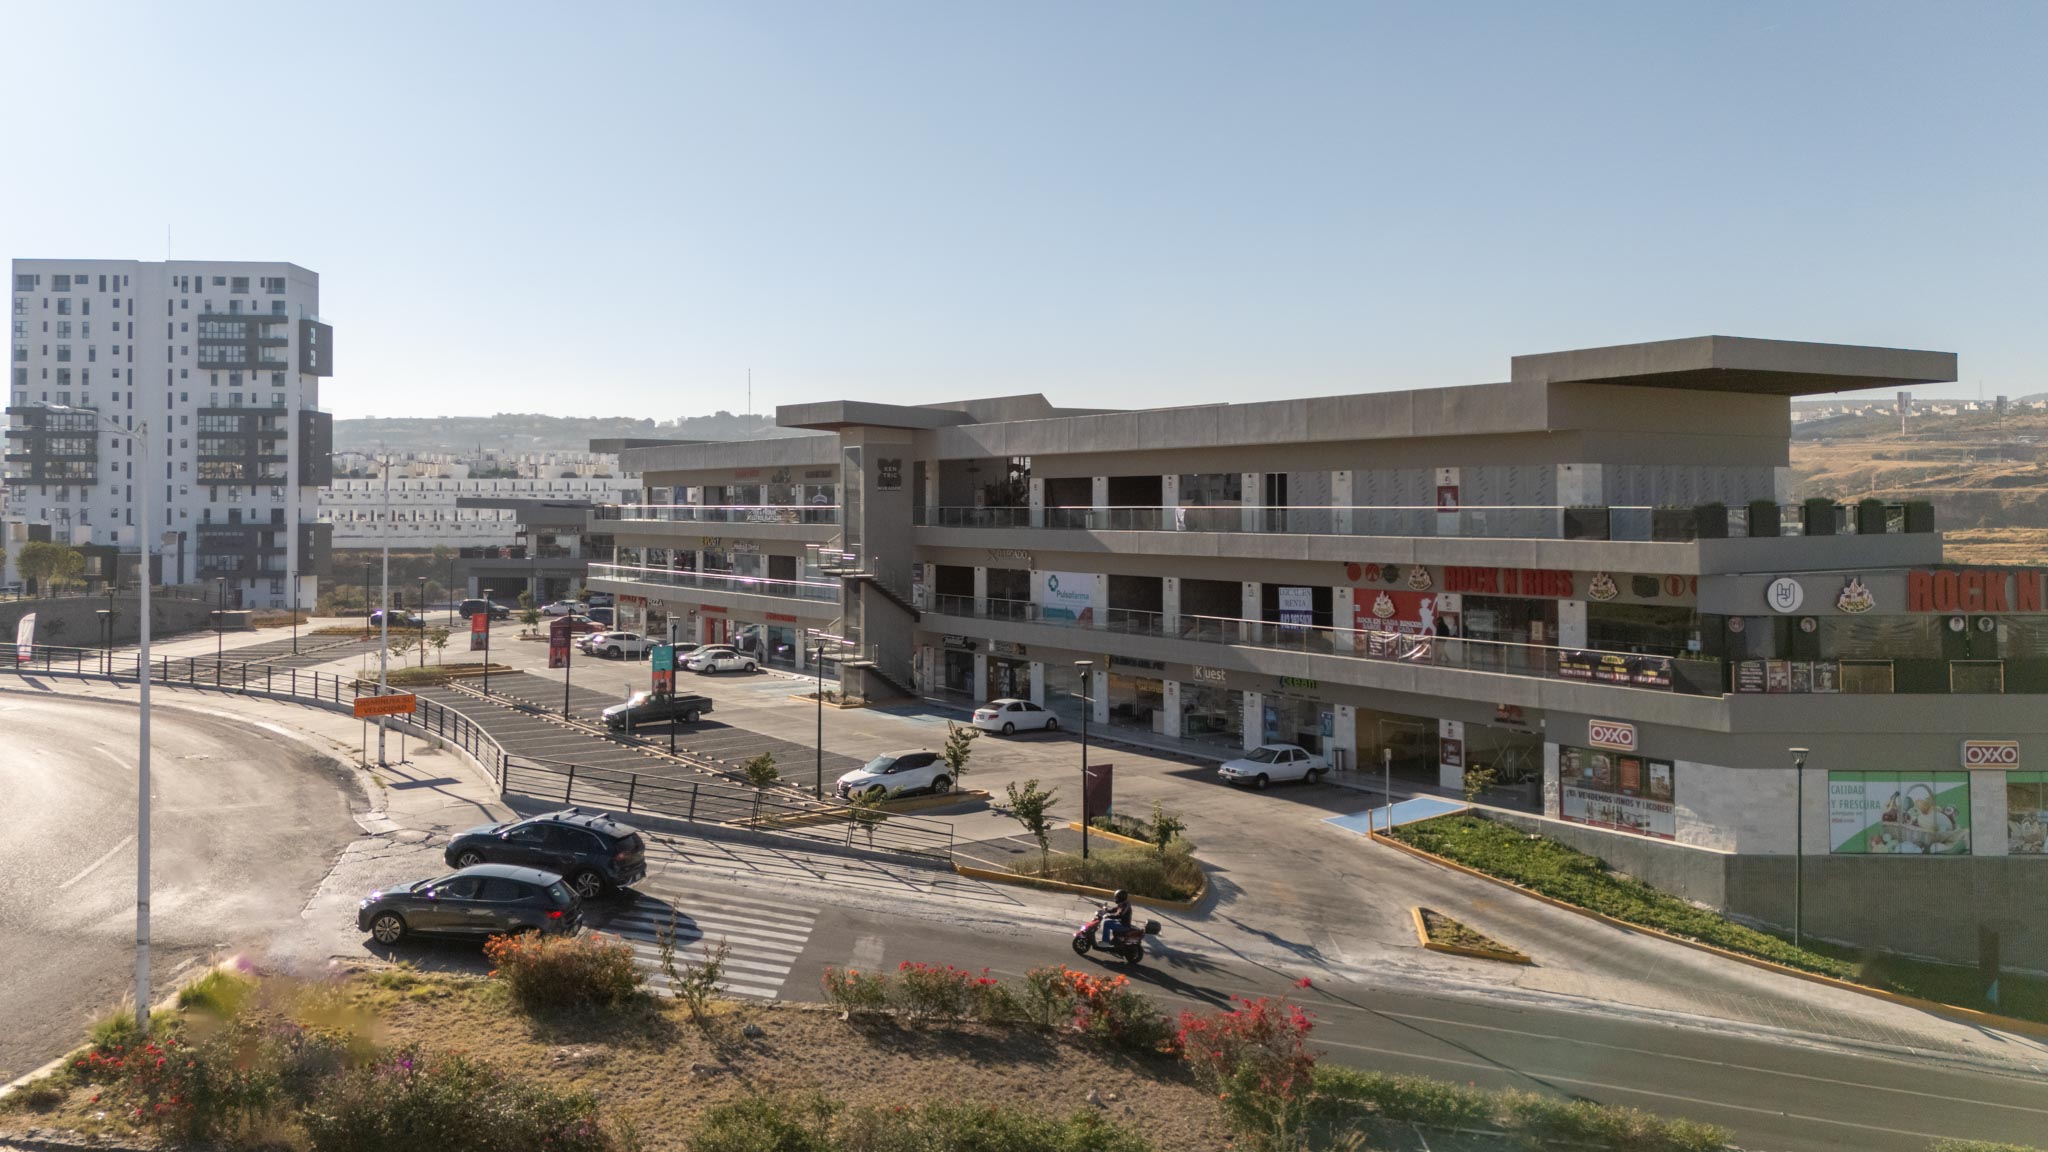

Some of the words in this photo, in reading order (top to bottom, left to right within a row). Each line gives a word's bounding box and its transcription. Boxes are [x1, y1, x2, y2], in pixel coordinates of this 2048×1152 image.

[1444, 565, 1499, 594] ROCK
[1503, 568, 1518, 595] N
[1521, 568, 1573, 597] RIBS
[1056, 590, 1089, 600] Pulsofarma
[1280, 588, 1301, 597] LOCAL
[1907, 569, 2010, 612] ROCK
[2017, 570, 2042, 612] N
[1284, 599, 1306, 608] RENTA
[363, 704, 407, 713] VELOCIDAD
[1591, 726, 1632, 744] OXXO
[1967, 746, 2017, 764] OXXO
[1831, 784, 1865, 795] CALIDAD
[1578, 790, 1612, 804] VENDEMOS
[1831, 799, 1837, 809] Y
[1839, 799, 1881, 810] FRESCURA
